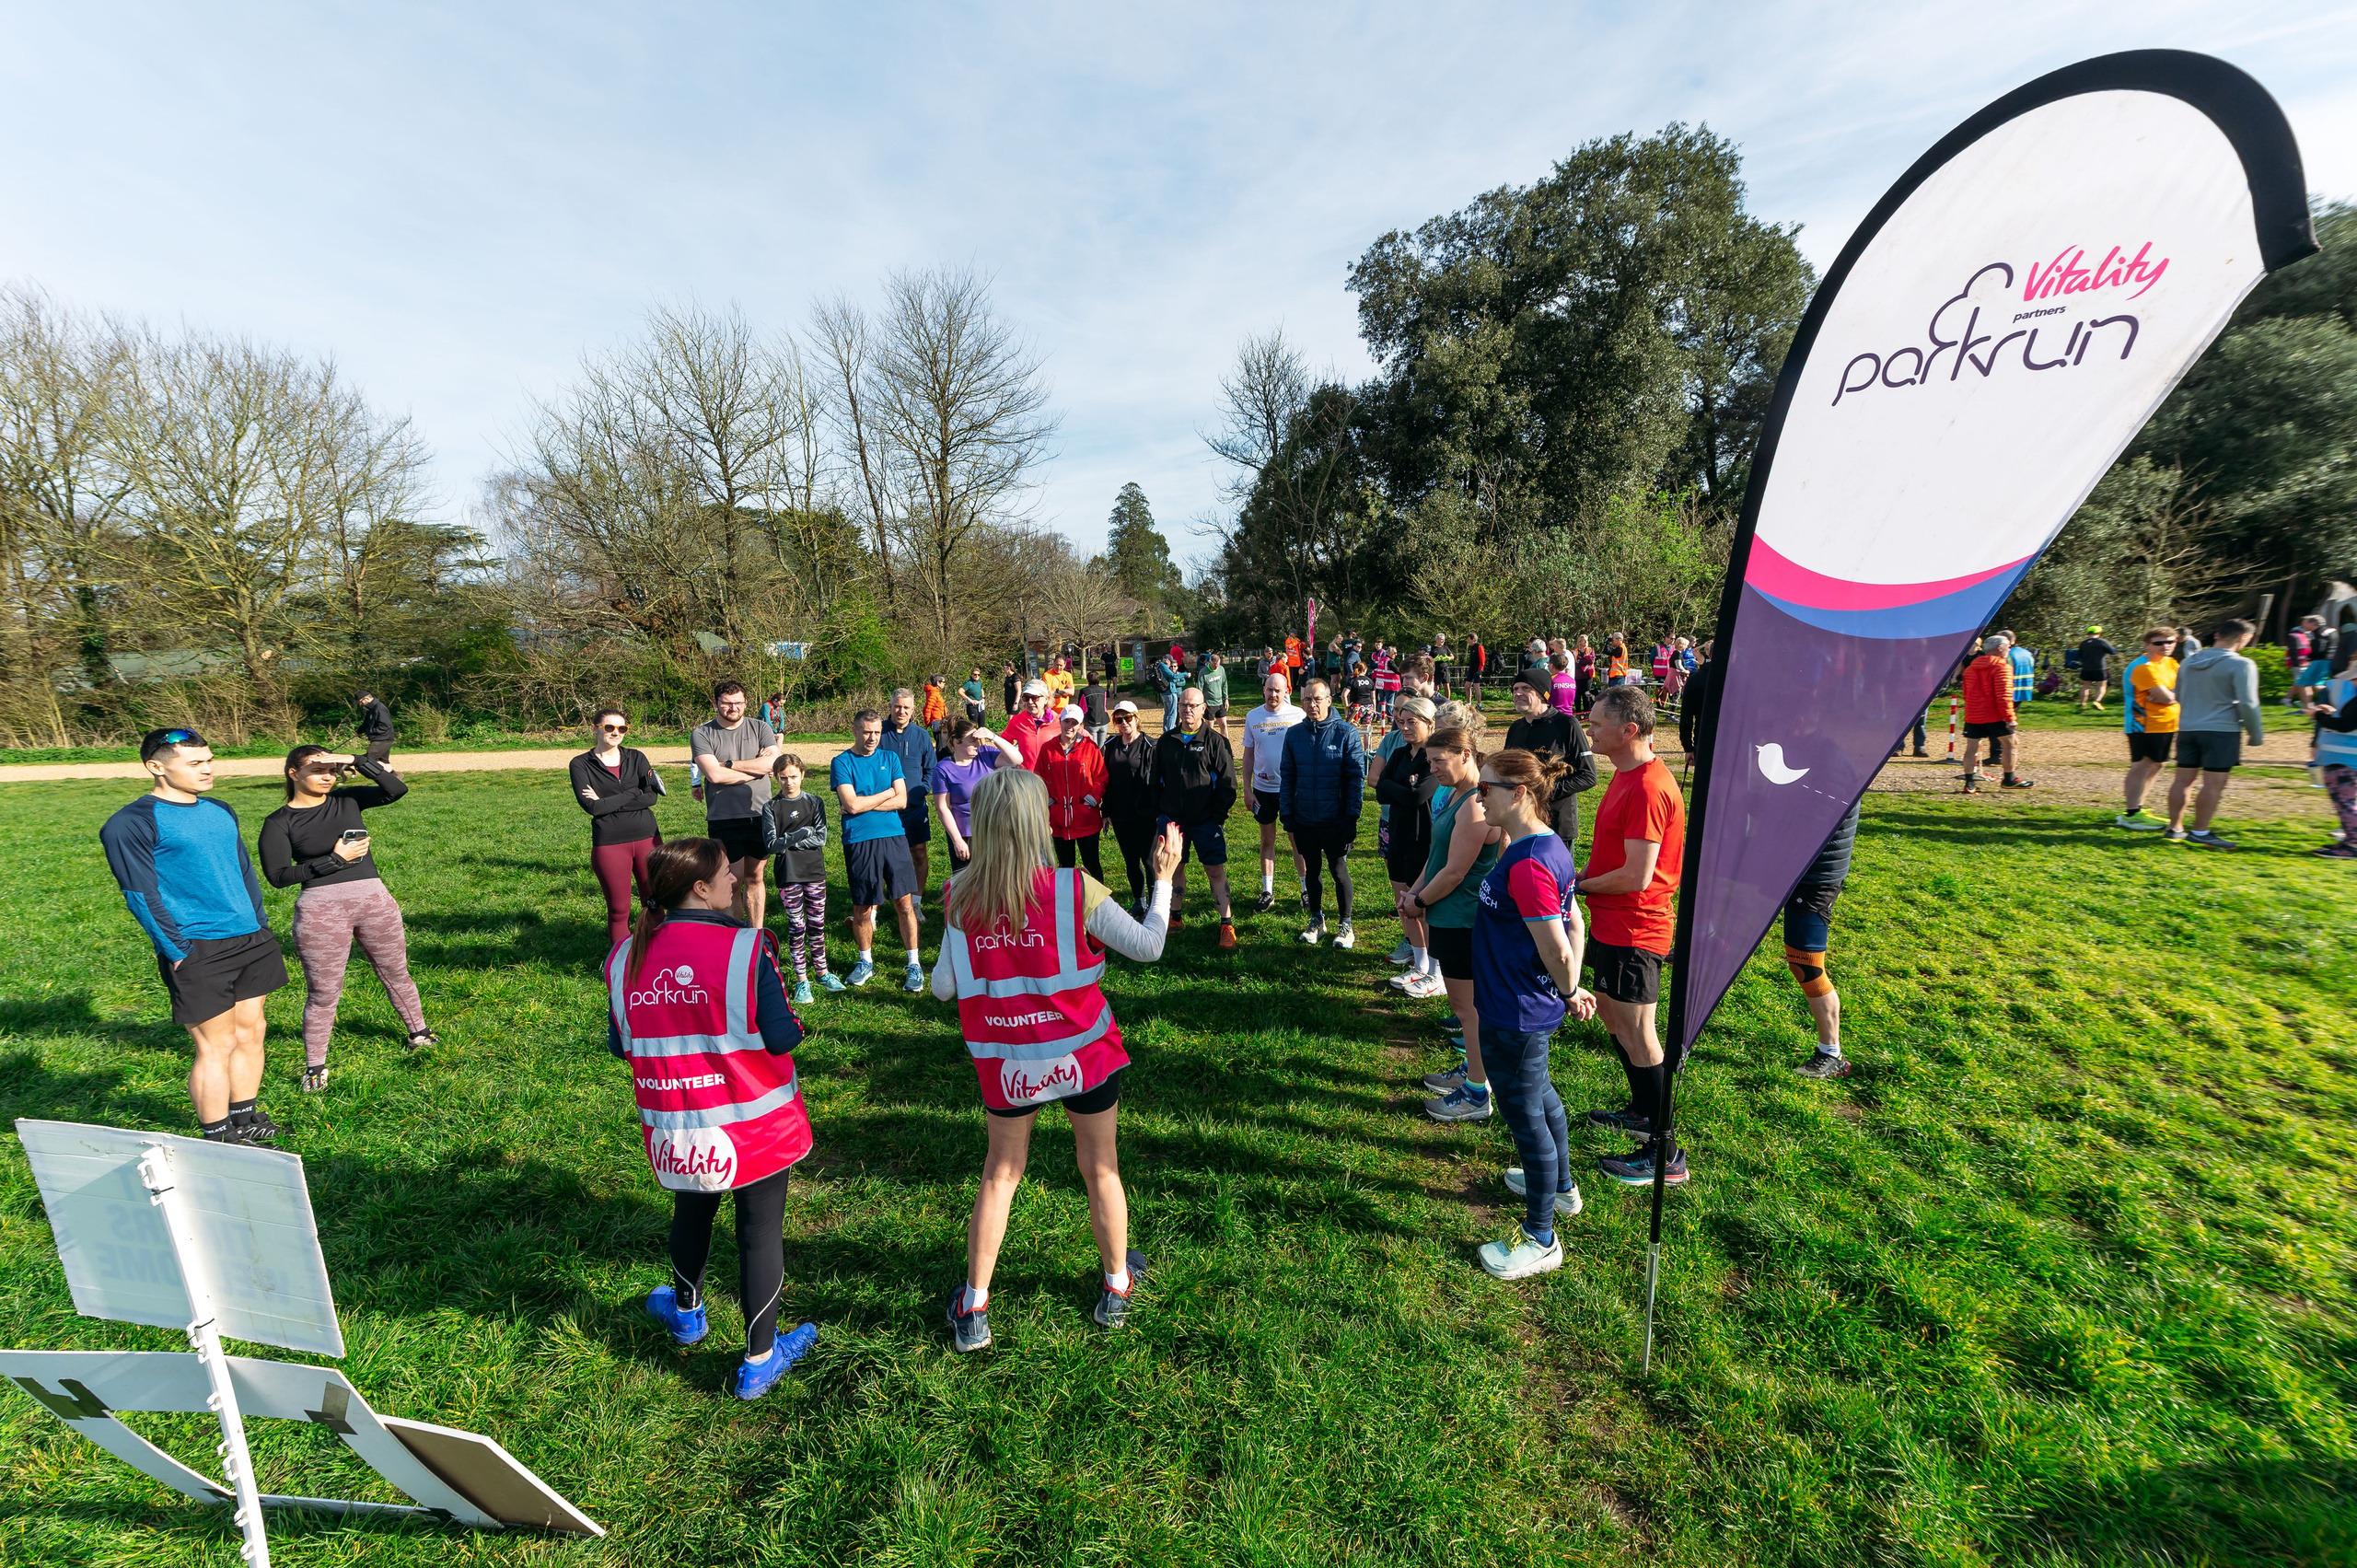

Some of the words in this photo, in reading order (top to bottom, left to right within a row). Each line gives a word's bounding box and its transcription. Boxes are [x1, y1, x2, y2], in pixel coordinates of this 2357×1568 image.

[2024, 241, 2170, 301] Vitality
[2012, 305, 2066, 323] partners
[1831, 304, 2140, 407] parkrun
[630, 978, 708, 1010] parkrun
[984, 1010, 1064, 1028] VOLUNTEER
[636, 1074, 726, 1091] VOLUNTEER
[653, 1139, 732, 1185] Vitality
